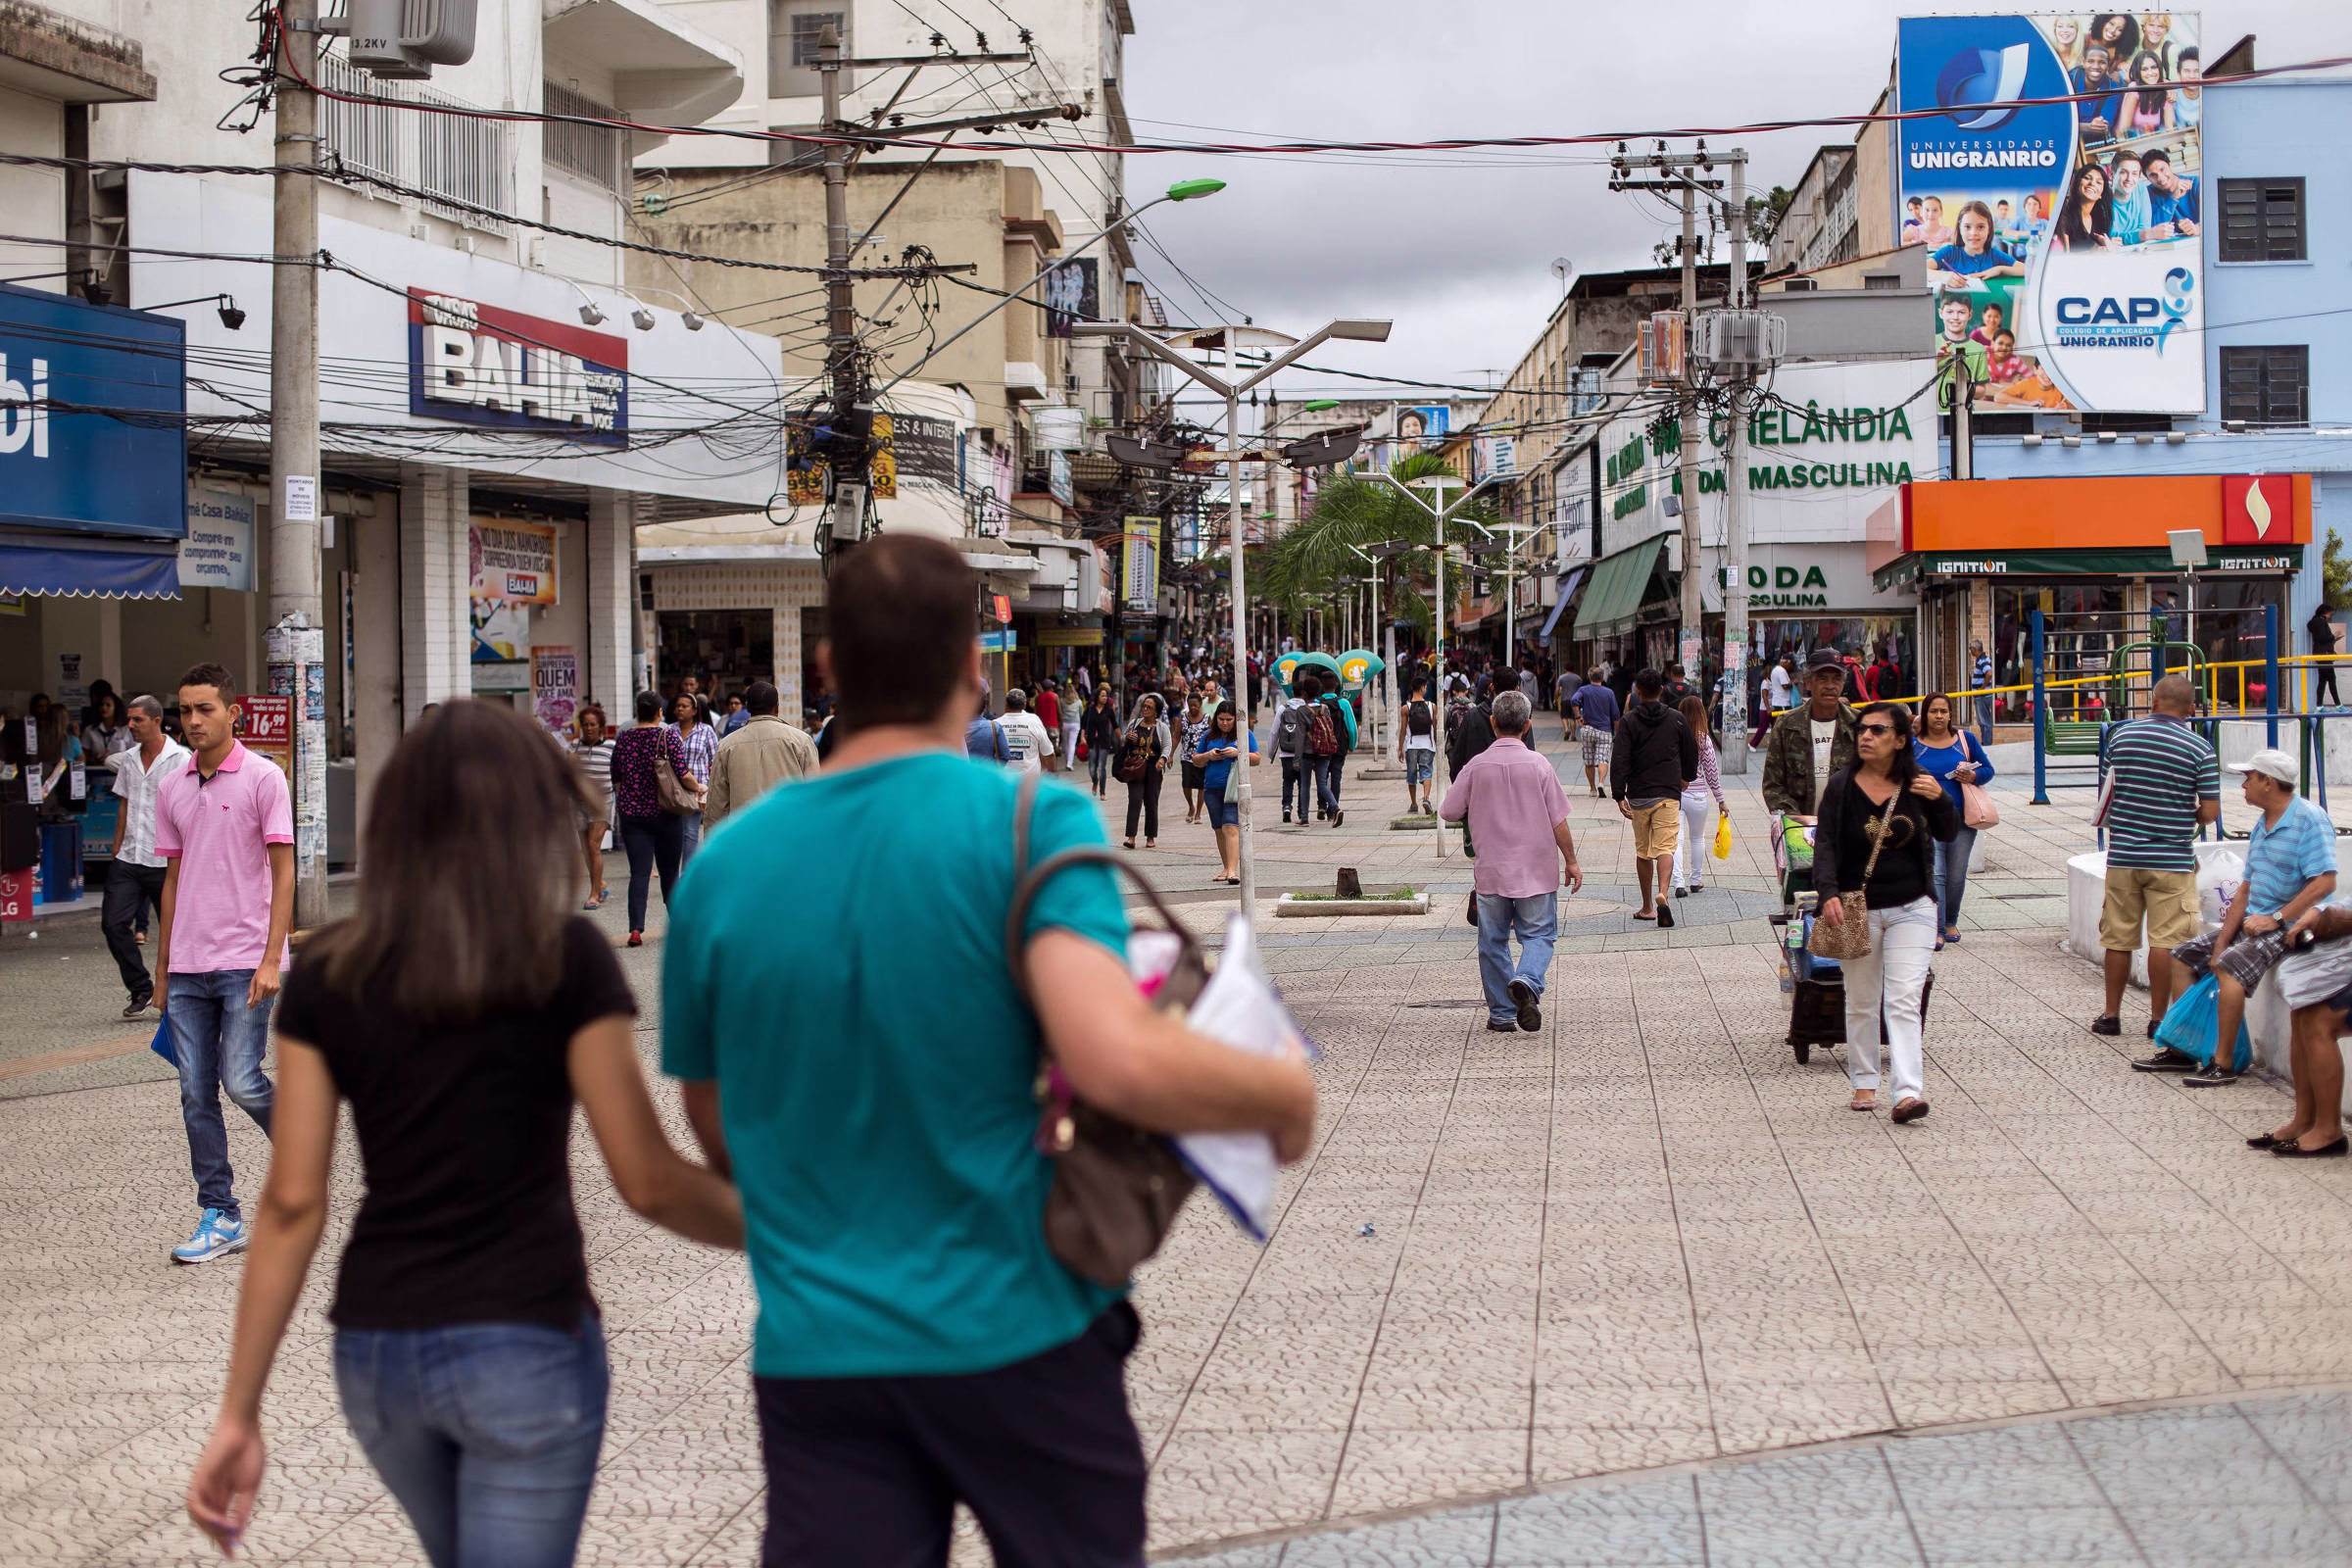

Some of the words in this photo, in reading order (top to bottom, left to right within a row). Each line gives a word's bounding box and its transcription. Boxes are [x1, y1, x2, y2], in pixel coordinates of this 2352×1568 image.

[1912, 139, 2055, 151] UNIVERSIDADE
[1911, 150, 2057, 170] UNIGRANRIO
[2057, 297, 2161, 324] CAP
[2111, 325, 2154, 335] APLICAÇÃO
[2060, 336, 2155, 347] UNIGRANRIO
[423, 324, 595, 426] BAHIA
[1709, 399, 1913, 448] CELÂNDIA
[1672, 468, 1728, 495] MDA
[1748, 461, 1913, 490] MASCULINA
[1936, 557, 2007, 573] IGNITION
[2220, 555, 2290, 570] IGNITION
[535, 668, 576, 688] QUEM
[252, 712, 286, 735] 16,99
